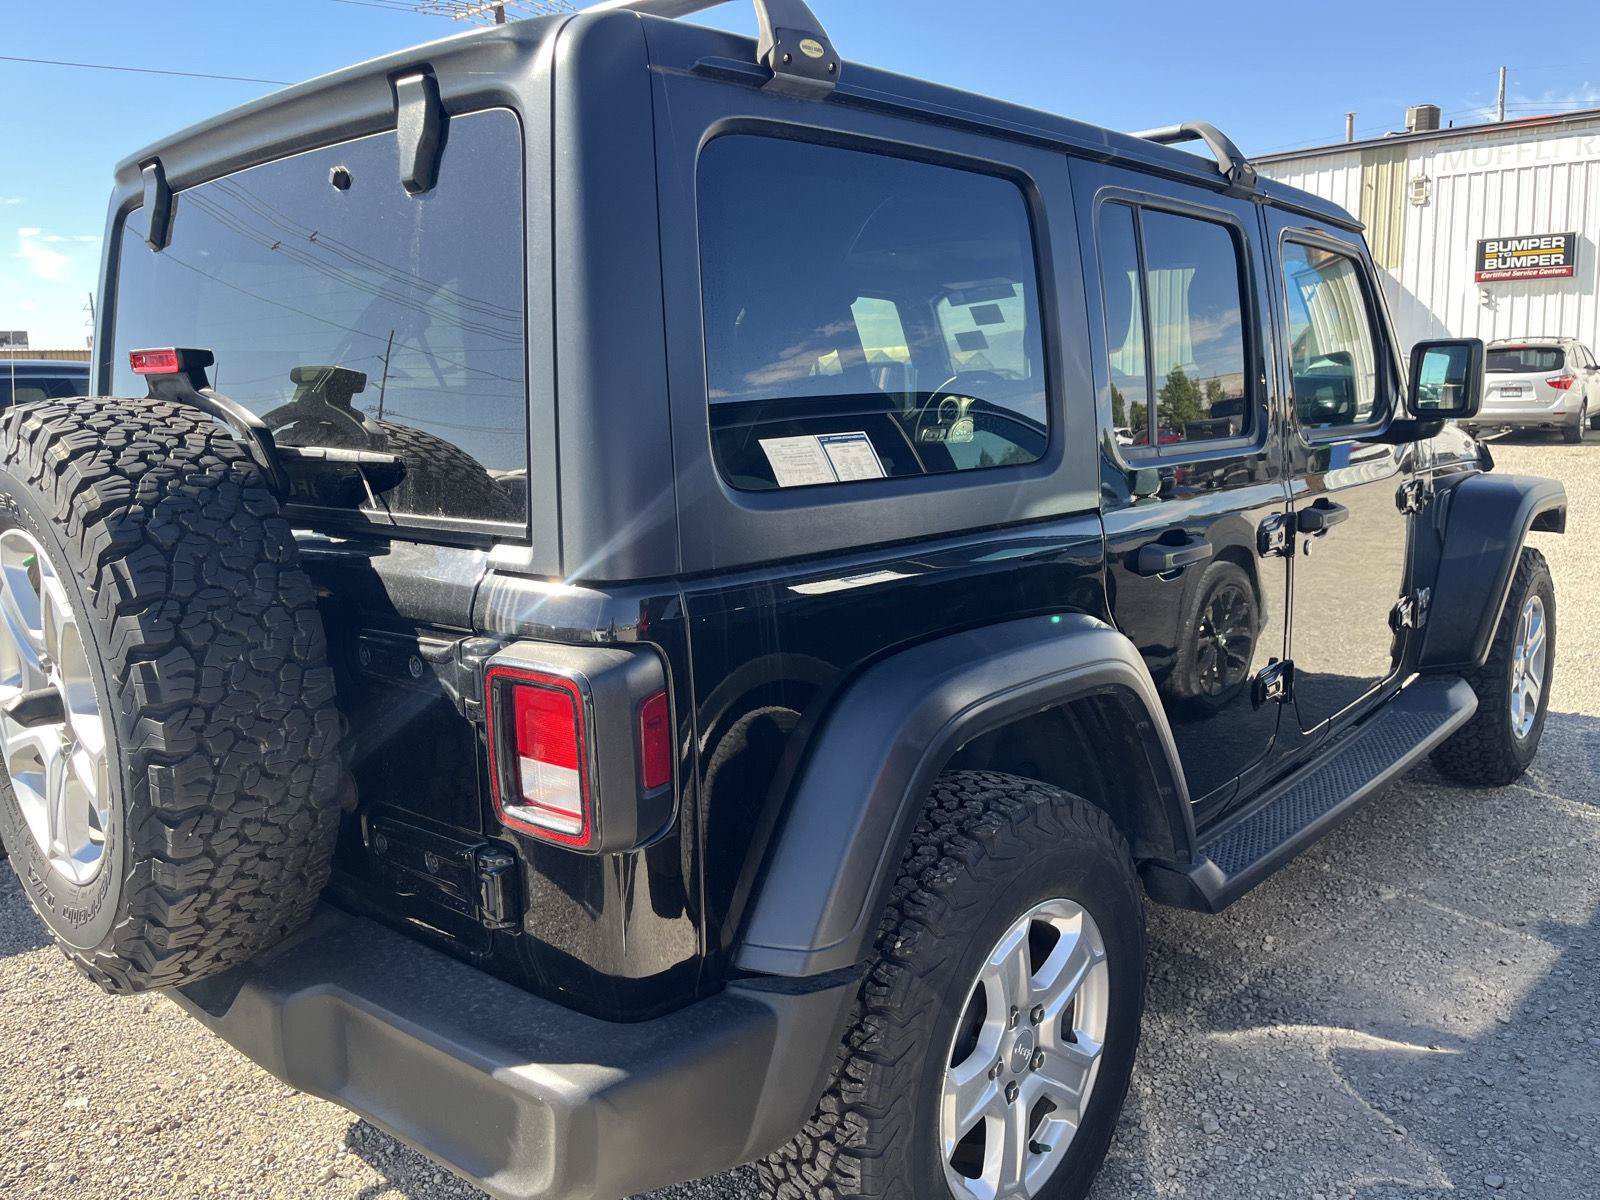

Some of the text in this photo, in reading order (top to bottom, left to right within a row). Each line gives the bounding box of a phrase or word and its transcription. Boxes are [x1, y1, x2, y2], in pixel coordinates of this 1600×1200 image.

[1485, 236, 1565, 253] BUMPER
[1484, 254, 1564, 270] BUMPER
[1481, 271, 1511, 279] Certified
[1512, 269, 1538, 277] Service
[1014, 1044, 1031, 1060] Jeep
